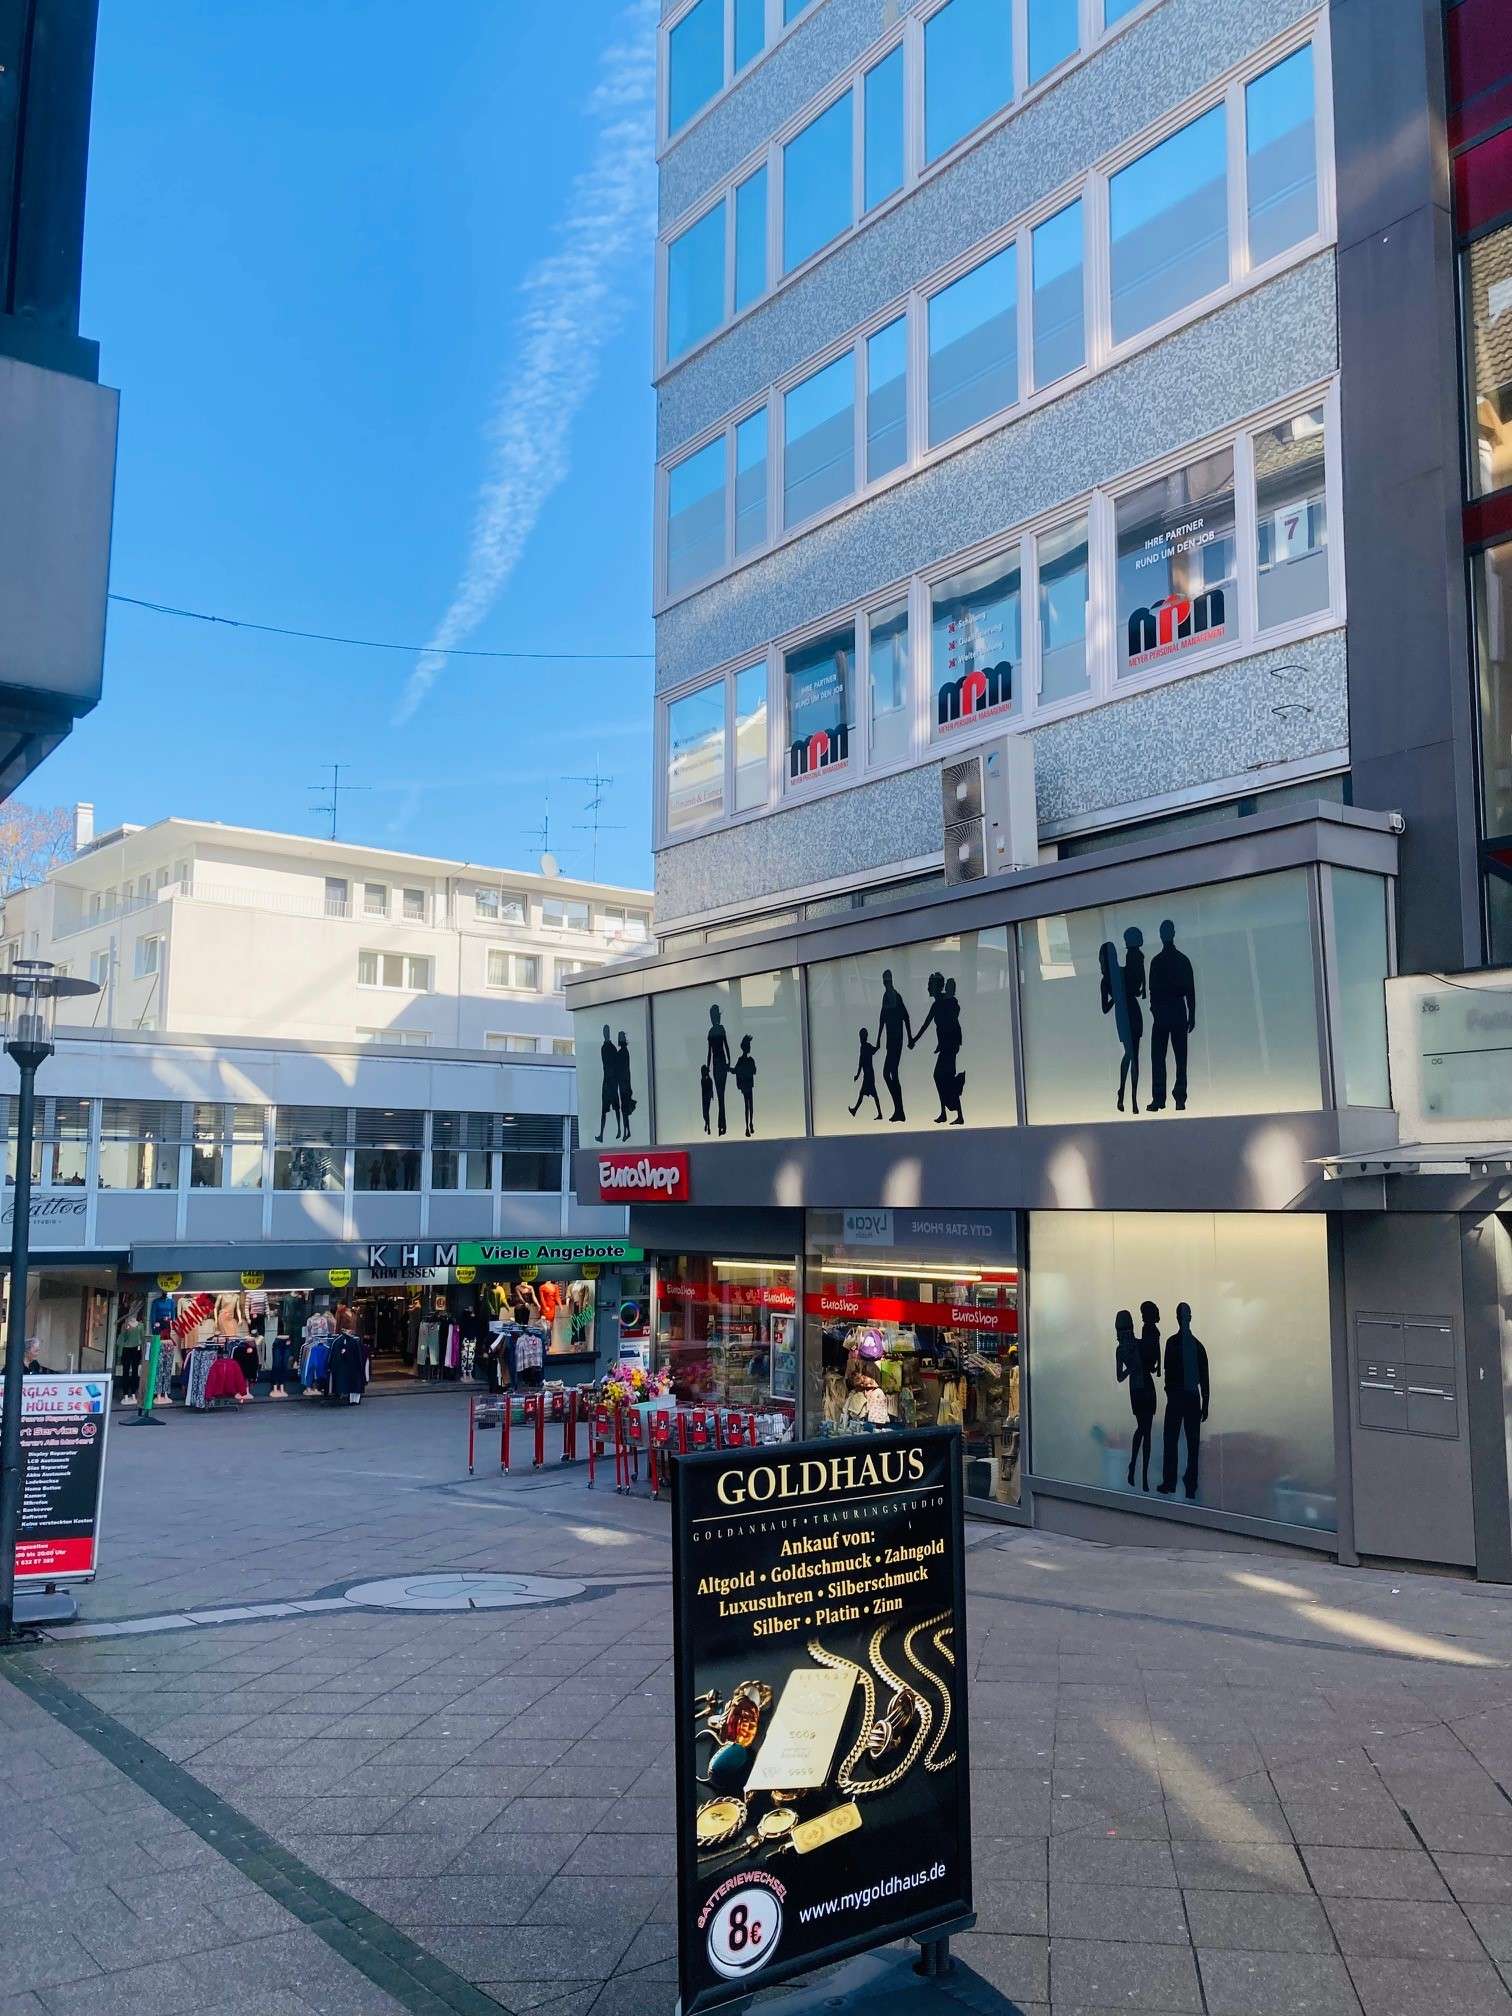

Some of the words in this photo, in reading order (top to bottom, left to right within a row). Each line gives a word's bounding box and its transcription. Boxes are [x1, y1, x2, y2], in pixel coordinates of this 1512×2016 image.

[1144, 536, 1164, 550] IHRE
[1165, 518, 1204, 542] PARTNER
[1284, 516, 1300, 540] 7
[1135, 554, 1160, 570] RUND
[1161, 548, 1175, 560] UM
[1176, 540, 1196, 554] DEN
[1196, 530, 1215, 546] JOB
[1128, 654, 1149, 668] MEYER
[1149, 645, 1180, 662] PERSONAL
[1180, 628, 1225, 650] MANAGEMENT
[813, 674, 837, 690] PARTNER
[938, 722, 954, 734] MEYER
[598, 1158, 680, 1196] EuroShop
[480, 1245, 530, 1260] Viele
[536, 1244, 625, 1261] Angebote
[371, 1268, 398, 1280] KHM
[400, 1266, 436, 1278] ESSEN
[666, 1284, 696, 1297] EuroShop
[820, 1298, 859, 1313] EuroShop
[952, 1308, 998, 1326] EuroShop
[22, 1386, 58, 1398] RGLAS
[68, 1386, 83, 1396] 5€
[26, 1400, 64, 1412] HÜLLE
[67, 1402, 82, 1411] 5€
[33, 1426, 78, 1436] Service
[716, 1448, 924, 1506] GOLDHAUS
[693, 1517, 798, 1542] GOLDANKAUF
[813, 1496, 944, 1525] TRAURINGSTUDIO
[780, 1531, 840, 1557] Ankauf
[842, 1530, 876, 1547] von:
[697, 1570, 756, 1596] Altgold
[770, 1552, 872, 1584] Goldschmuck
[884, 1538, 945, 1564] Zahngold
[719, 1589, 814, 1618] Luxusuhren
[828, 1565, 929, 1599] Silberschmuck
[752, 1613, 801, 1637] Silber
[816, 1604, 860, 1626] Platin
[872, 1596, 903, 1616] Zinn
[696, 1870, 788, 1930] BATTERIEWECHSEL
[798, 1861, 946, 1924] www.mygoldhaus.de
[728, 1903, 762, 1952] 8€
